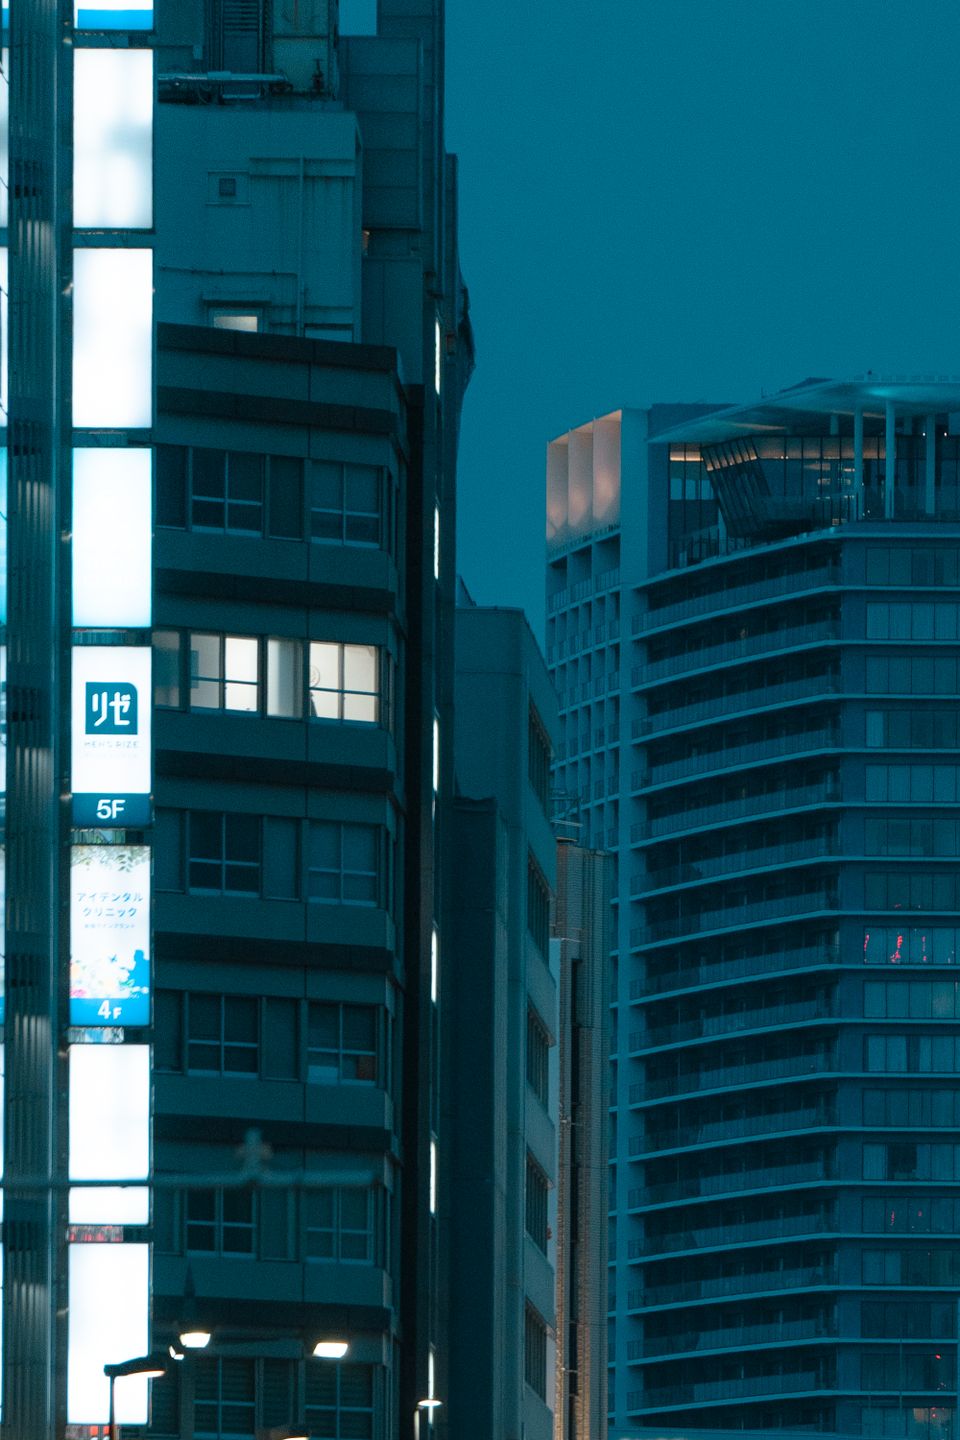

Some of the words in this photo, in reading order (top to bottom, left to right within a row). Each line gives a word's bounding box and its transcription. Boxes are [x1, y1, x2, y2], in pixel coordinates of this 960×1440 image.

[91, 692, 131, 728] リゼ
[96, 799, 126, 820] 5F
[81, 906, 138, 919] クリニック
[97, 1002, 122, 1020] 4F
